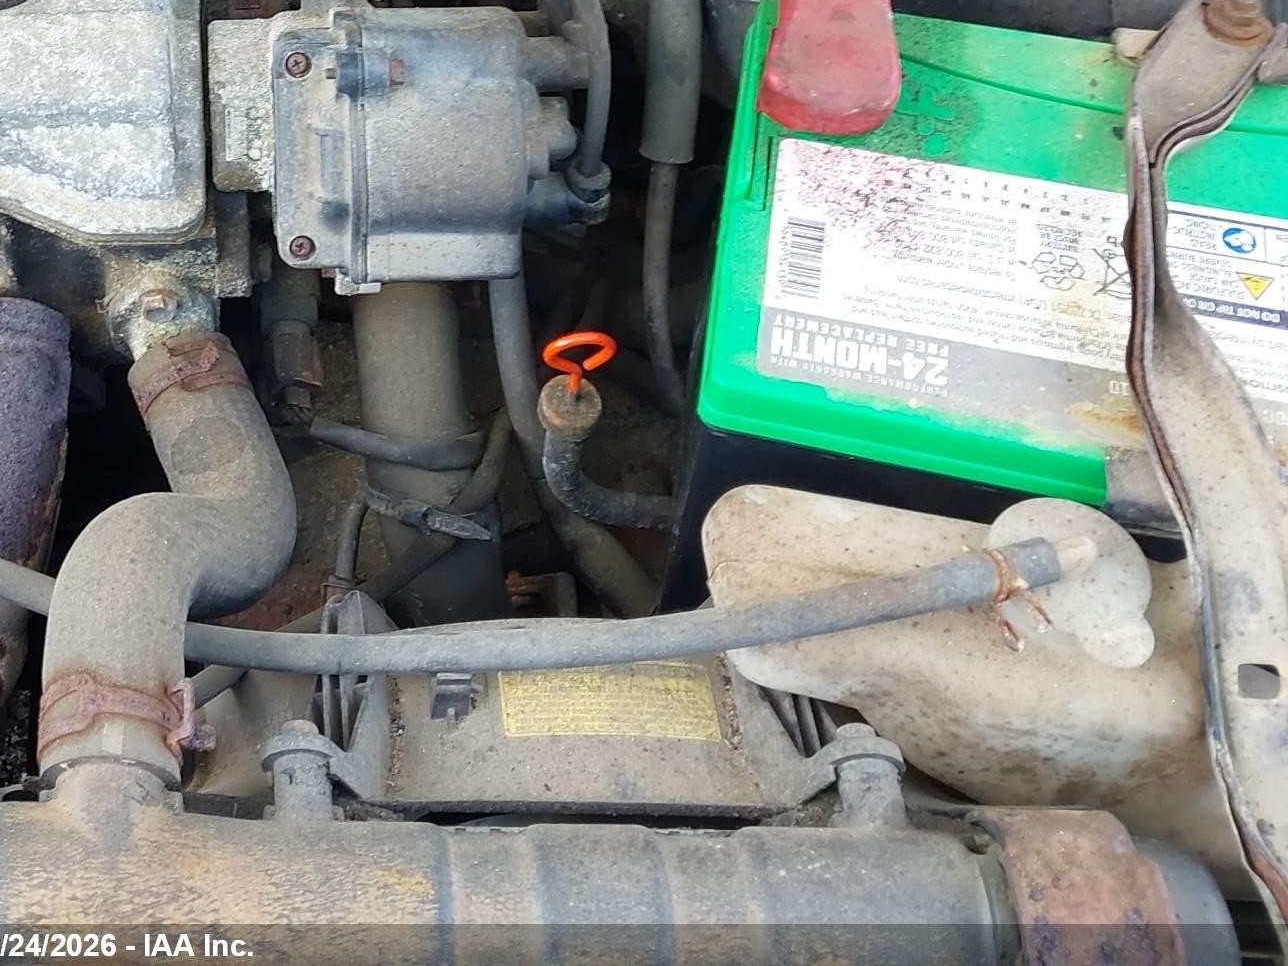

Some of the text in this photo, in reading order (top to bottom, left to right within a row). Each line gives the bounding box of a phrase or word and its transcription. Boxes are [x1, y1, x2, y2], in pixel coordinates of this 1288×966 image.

[774, 313, 898, 347] REPLACEMENT
[770, 325, 949, 387] 24-MONTH
[905, 338, 949, 358] FREE
